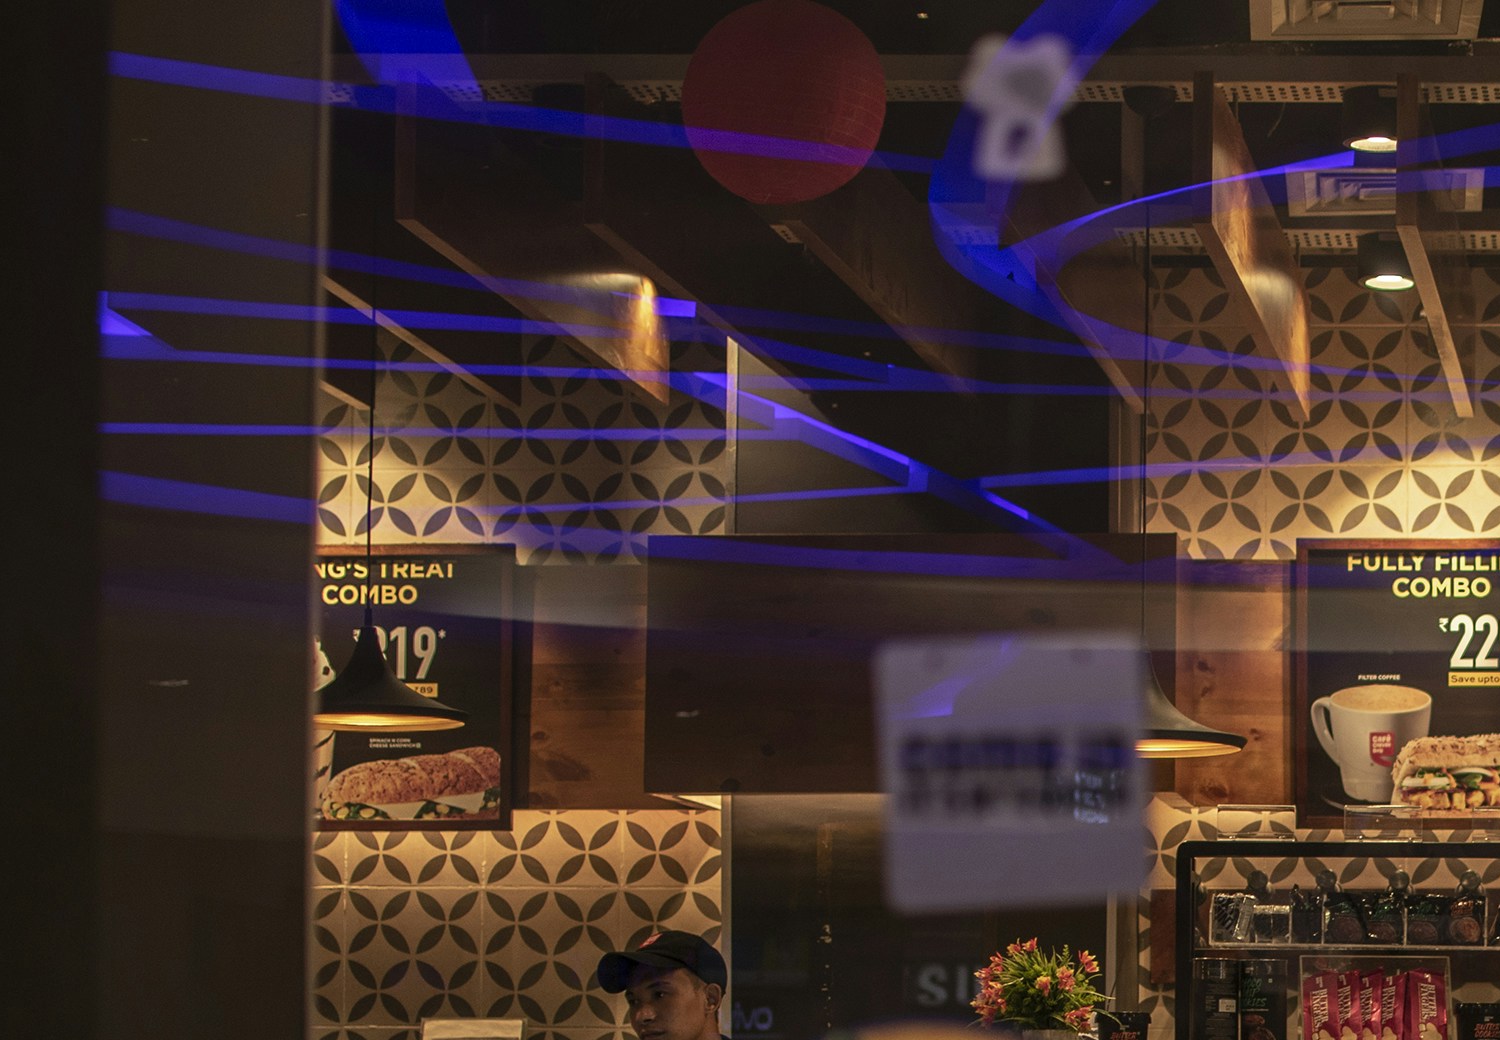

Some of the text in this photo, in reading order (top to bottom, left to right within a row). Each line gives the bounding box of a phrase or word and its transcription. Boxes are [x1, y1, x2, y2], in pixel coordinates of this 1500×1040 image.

[380, 561, 454, 578] TREAT
[1347, 554, 1425, 571] FULLY
[322, 585, 418, 605] COMBO
[1392, 577, 1492, 598] COMBO
[1478, 675, 1500, 684] upto
